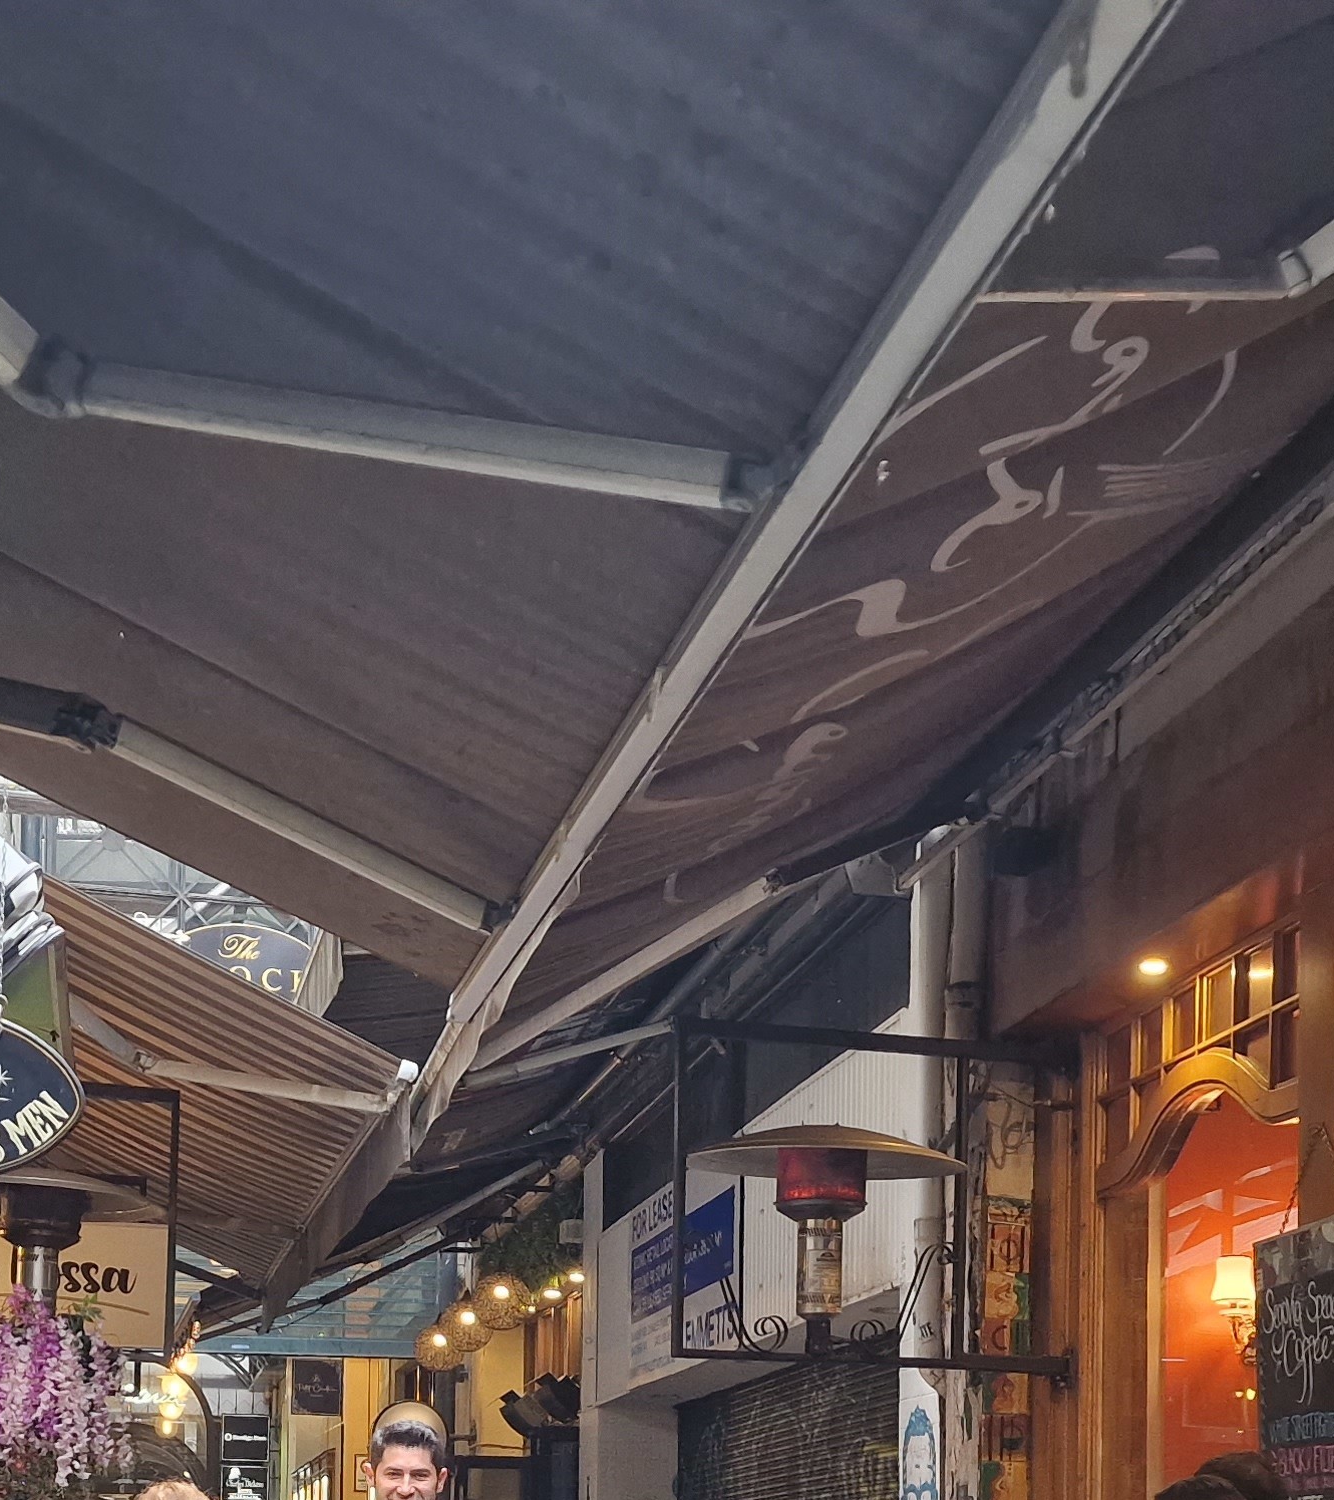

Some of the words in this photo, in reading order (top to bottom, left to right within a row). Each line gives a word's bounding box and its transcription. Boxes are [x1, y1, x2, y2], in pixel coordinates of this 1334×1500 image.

[218, 934, 261, 960] The
[0, 1091, 69, 1155] MEN
[632, 1210, 646, 1242] FOR
[648, 1190, 674, 1232] LEASE
[1284, 1326, 1334, 1405] Coffee
